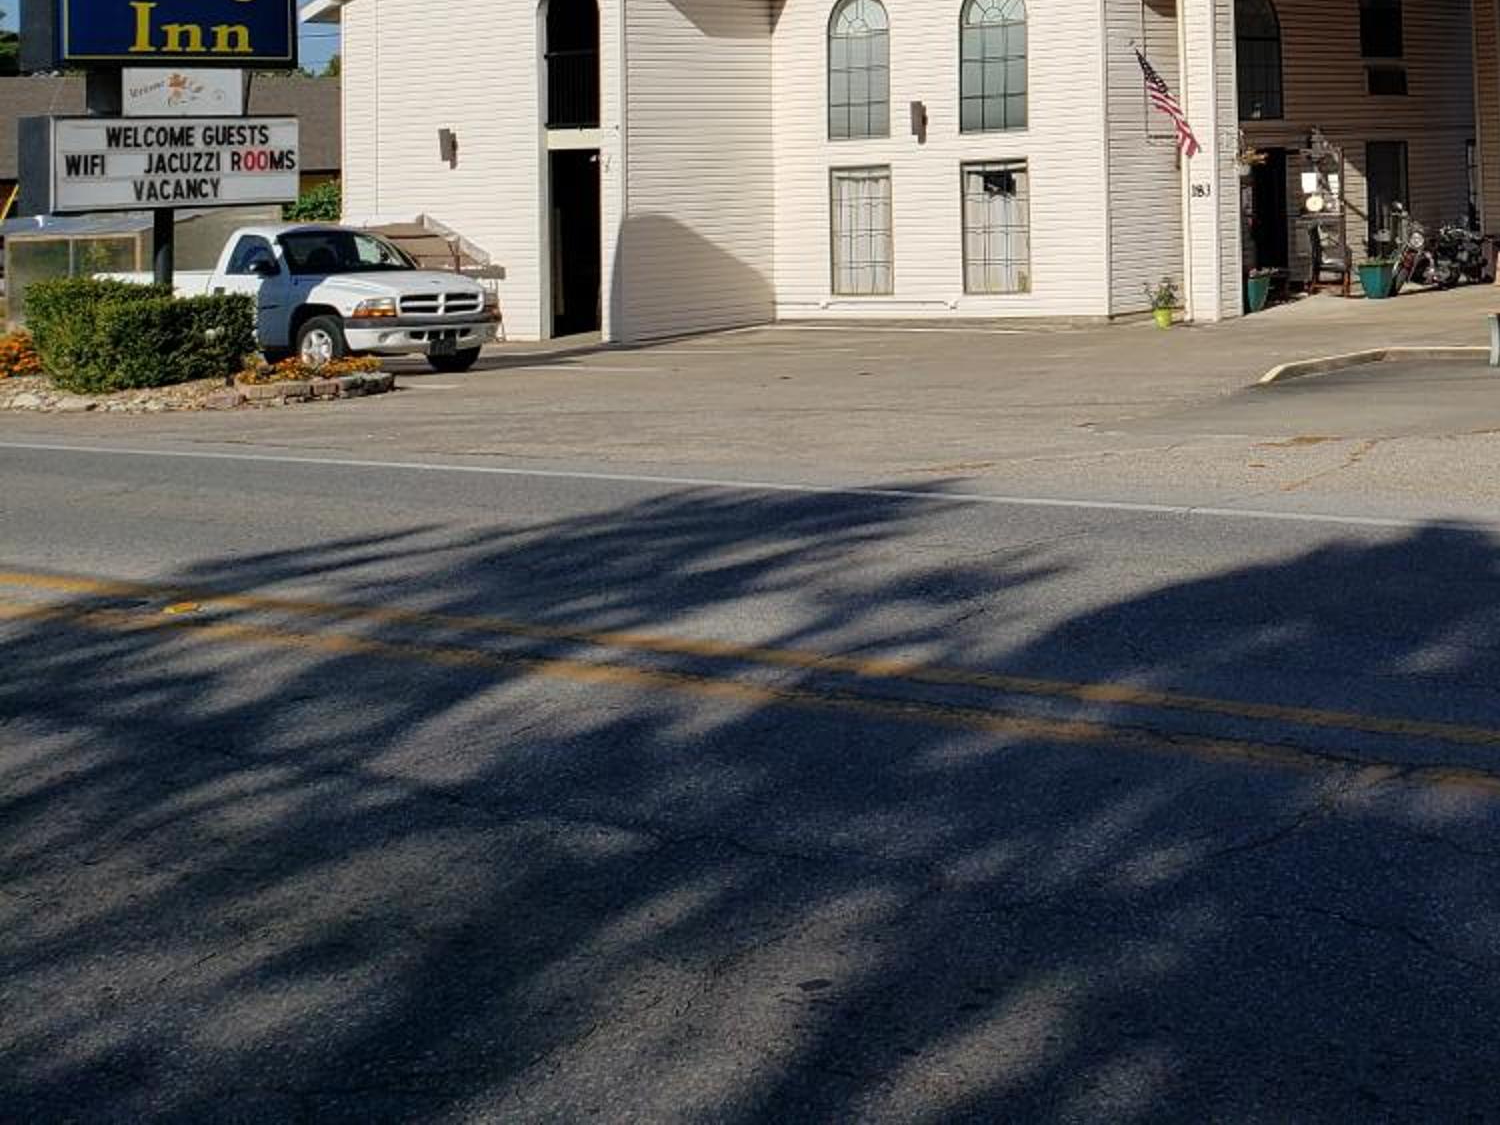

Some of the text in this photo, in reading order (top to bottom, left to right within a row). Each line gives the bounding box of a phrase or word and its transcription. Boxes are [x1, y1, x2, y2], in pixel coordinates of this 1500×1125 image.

[127, 1, 253, 53] Inn
[106, 125, 269, 149] WELCOME GUESTS
[65, 150, 296, 176] WIFI JACUZZI ROOMS
[133, 178, 220, 201] VACANCY
